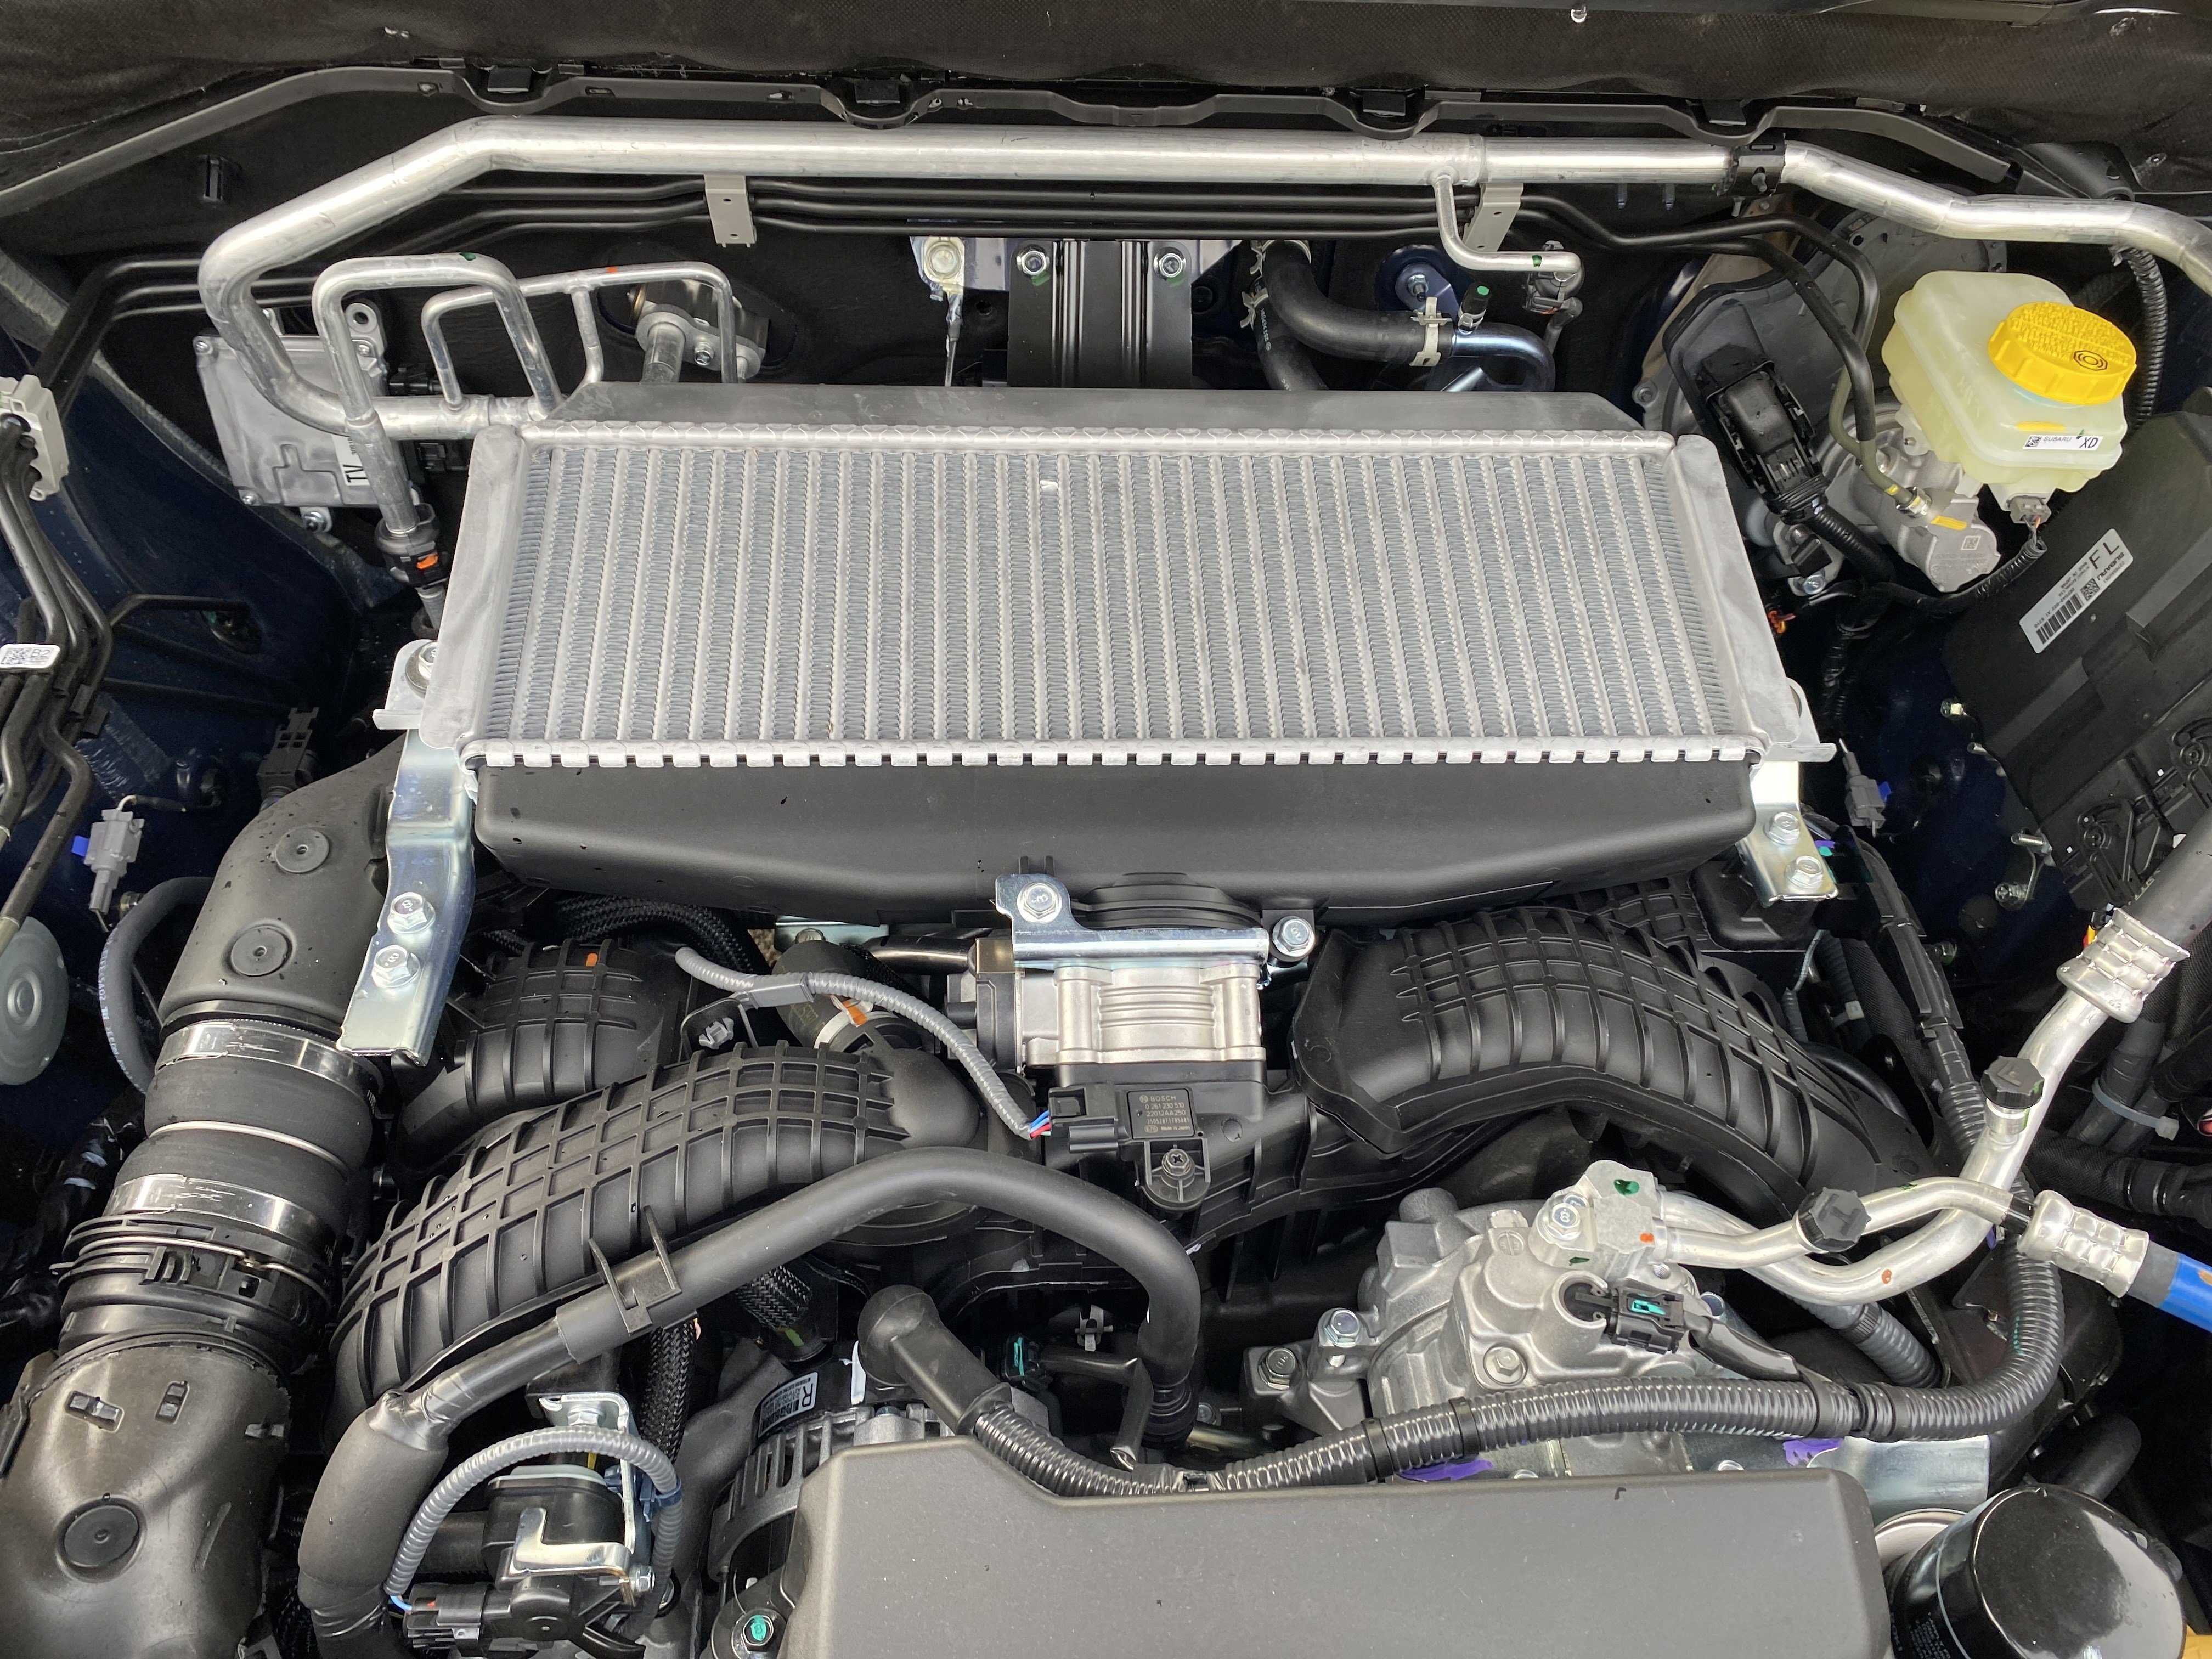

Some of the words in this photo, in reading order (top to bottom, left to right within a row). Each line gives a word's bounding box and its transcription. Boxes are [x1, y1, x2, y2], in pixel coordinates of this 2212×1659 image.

[2079, 437, 2099, 448] XD
[342, 464, 368, 483] TV
[2097, 552, 2125, 580] SUBARU
[30, 648, 50, 657] B2
[1818, 1193, 1861, 1236] H
[802, 1383, 814, 1408] R
